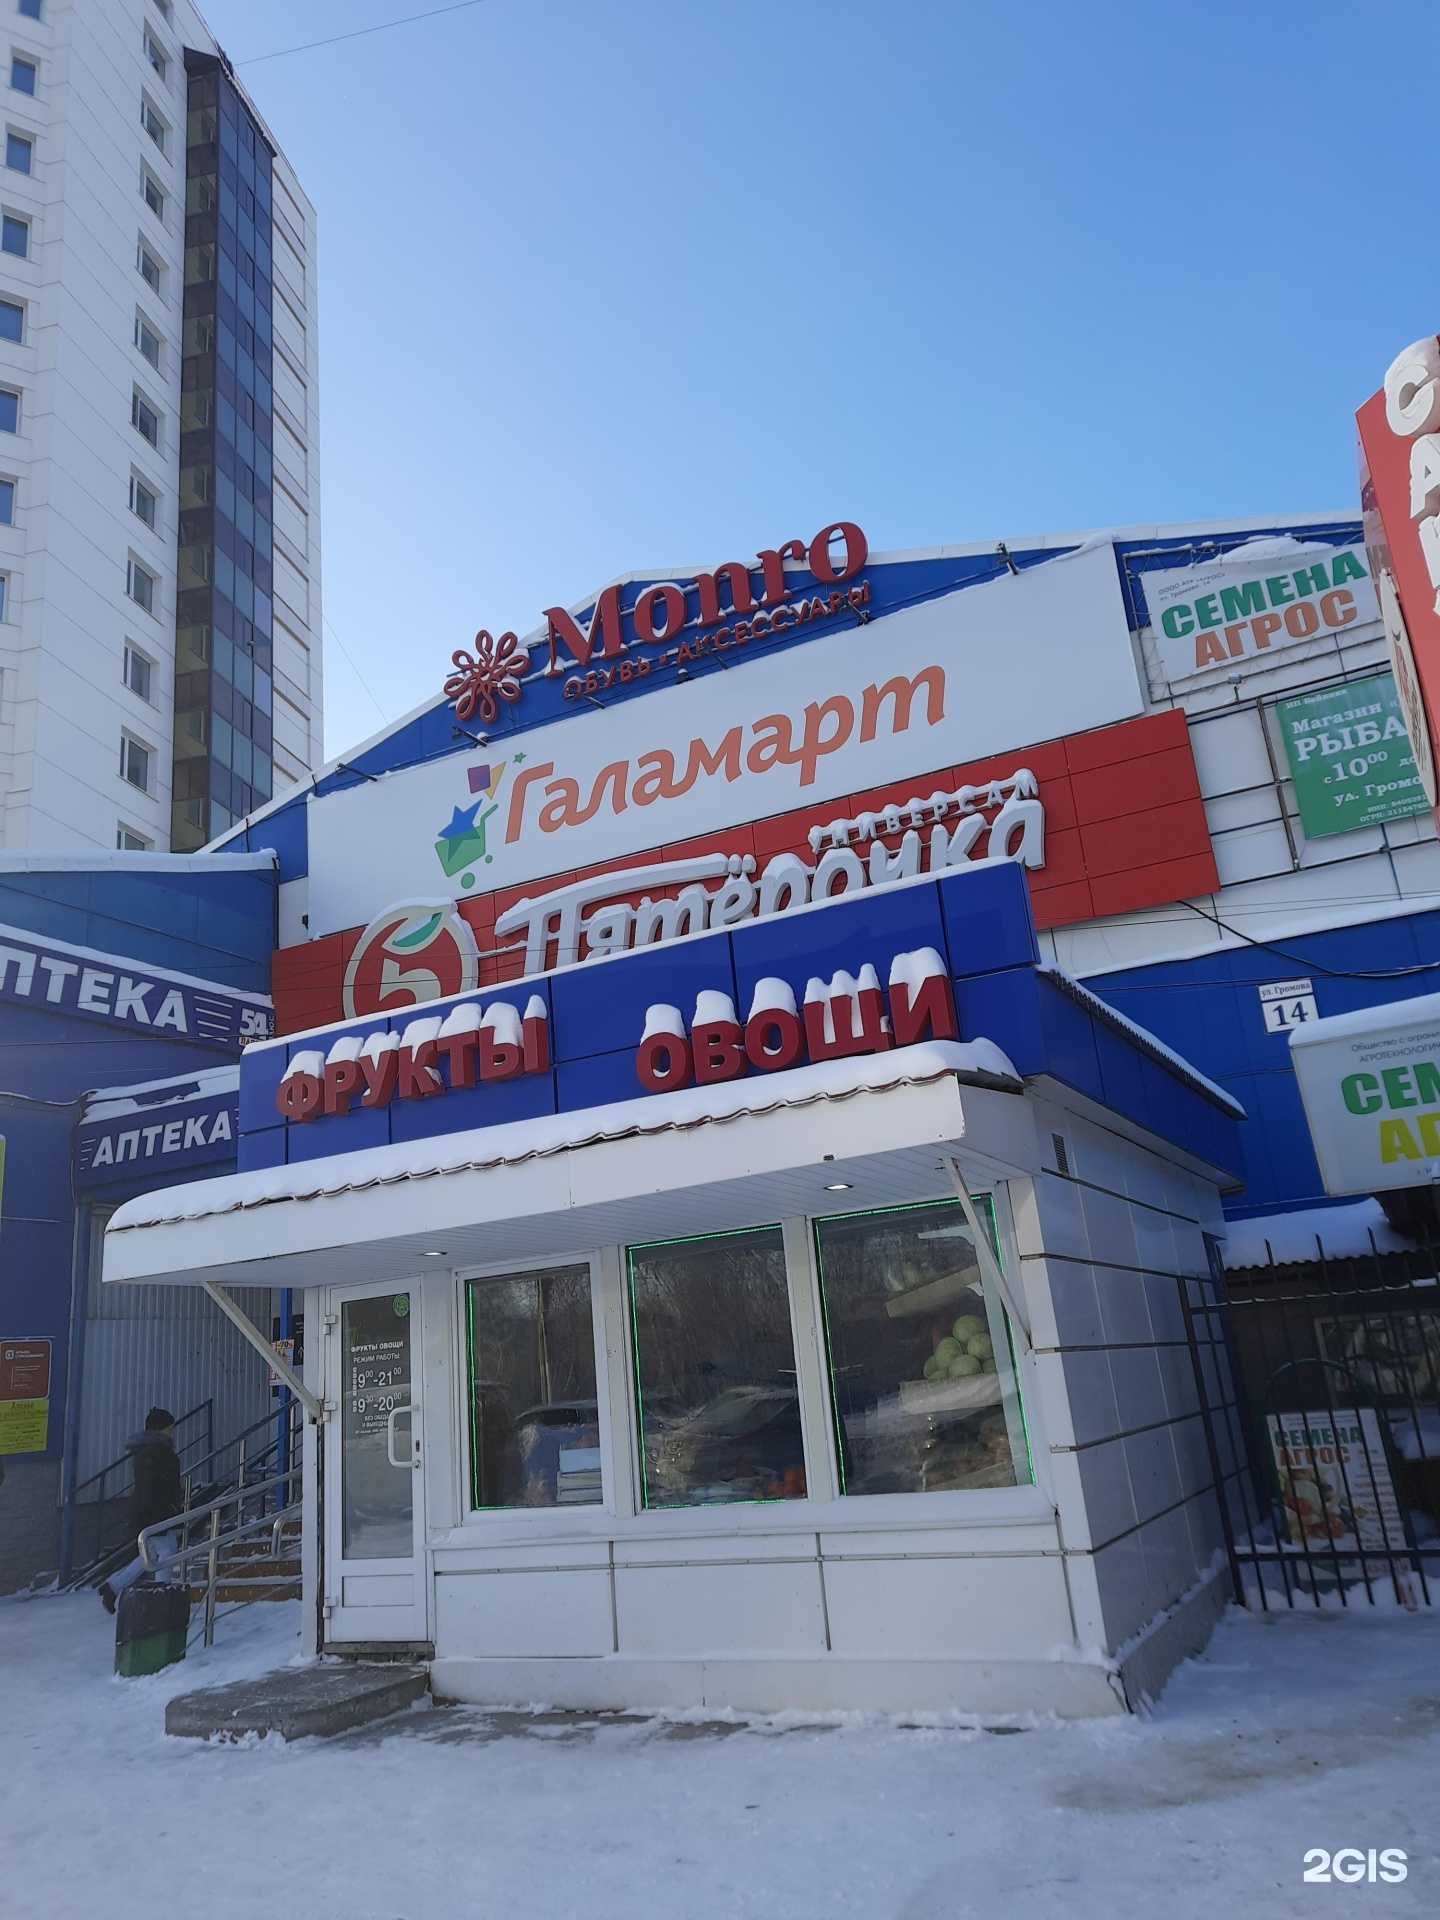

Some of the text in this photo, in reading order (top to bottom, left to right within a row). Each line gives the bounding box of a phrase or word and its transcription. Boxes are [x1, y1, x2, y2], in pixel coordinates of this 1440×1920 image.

[542, 521, 868, 677] Monro
[1161, 550, 1368, 639] СЕМЕНА
[1195, 590, 1357, 668] АГРОС
[562, 580, 871, 700] ОБУВЬ АКСЕССУАРЫ
[505, 666, 945, 843] Галамарт
[1291, 703, 1383, 734] Магазин
[1294, 716, 1408, 762] РЫБА
[808, 770, 1039, 854] УНИВЕРСАМ
[1334, 793, 1360, 807] ул.
[275, 968, 959, 1122] ФРУКТЫ ОВОЩИ
[1273, 1001, 1309, 1027] 14
[91, 1110, 233, 1169] АПТЕКА
